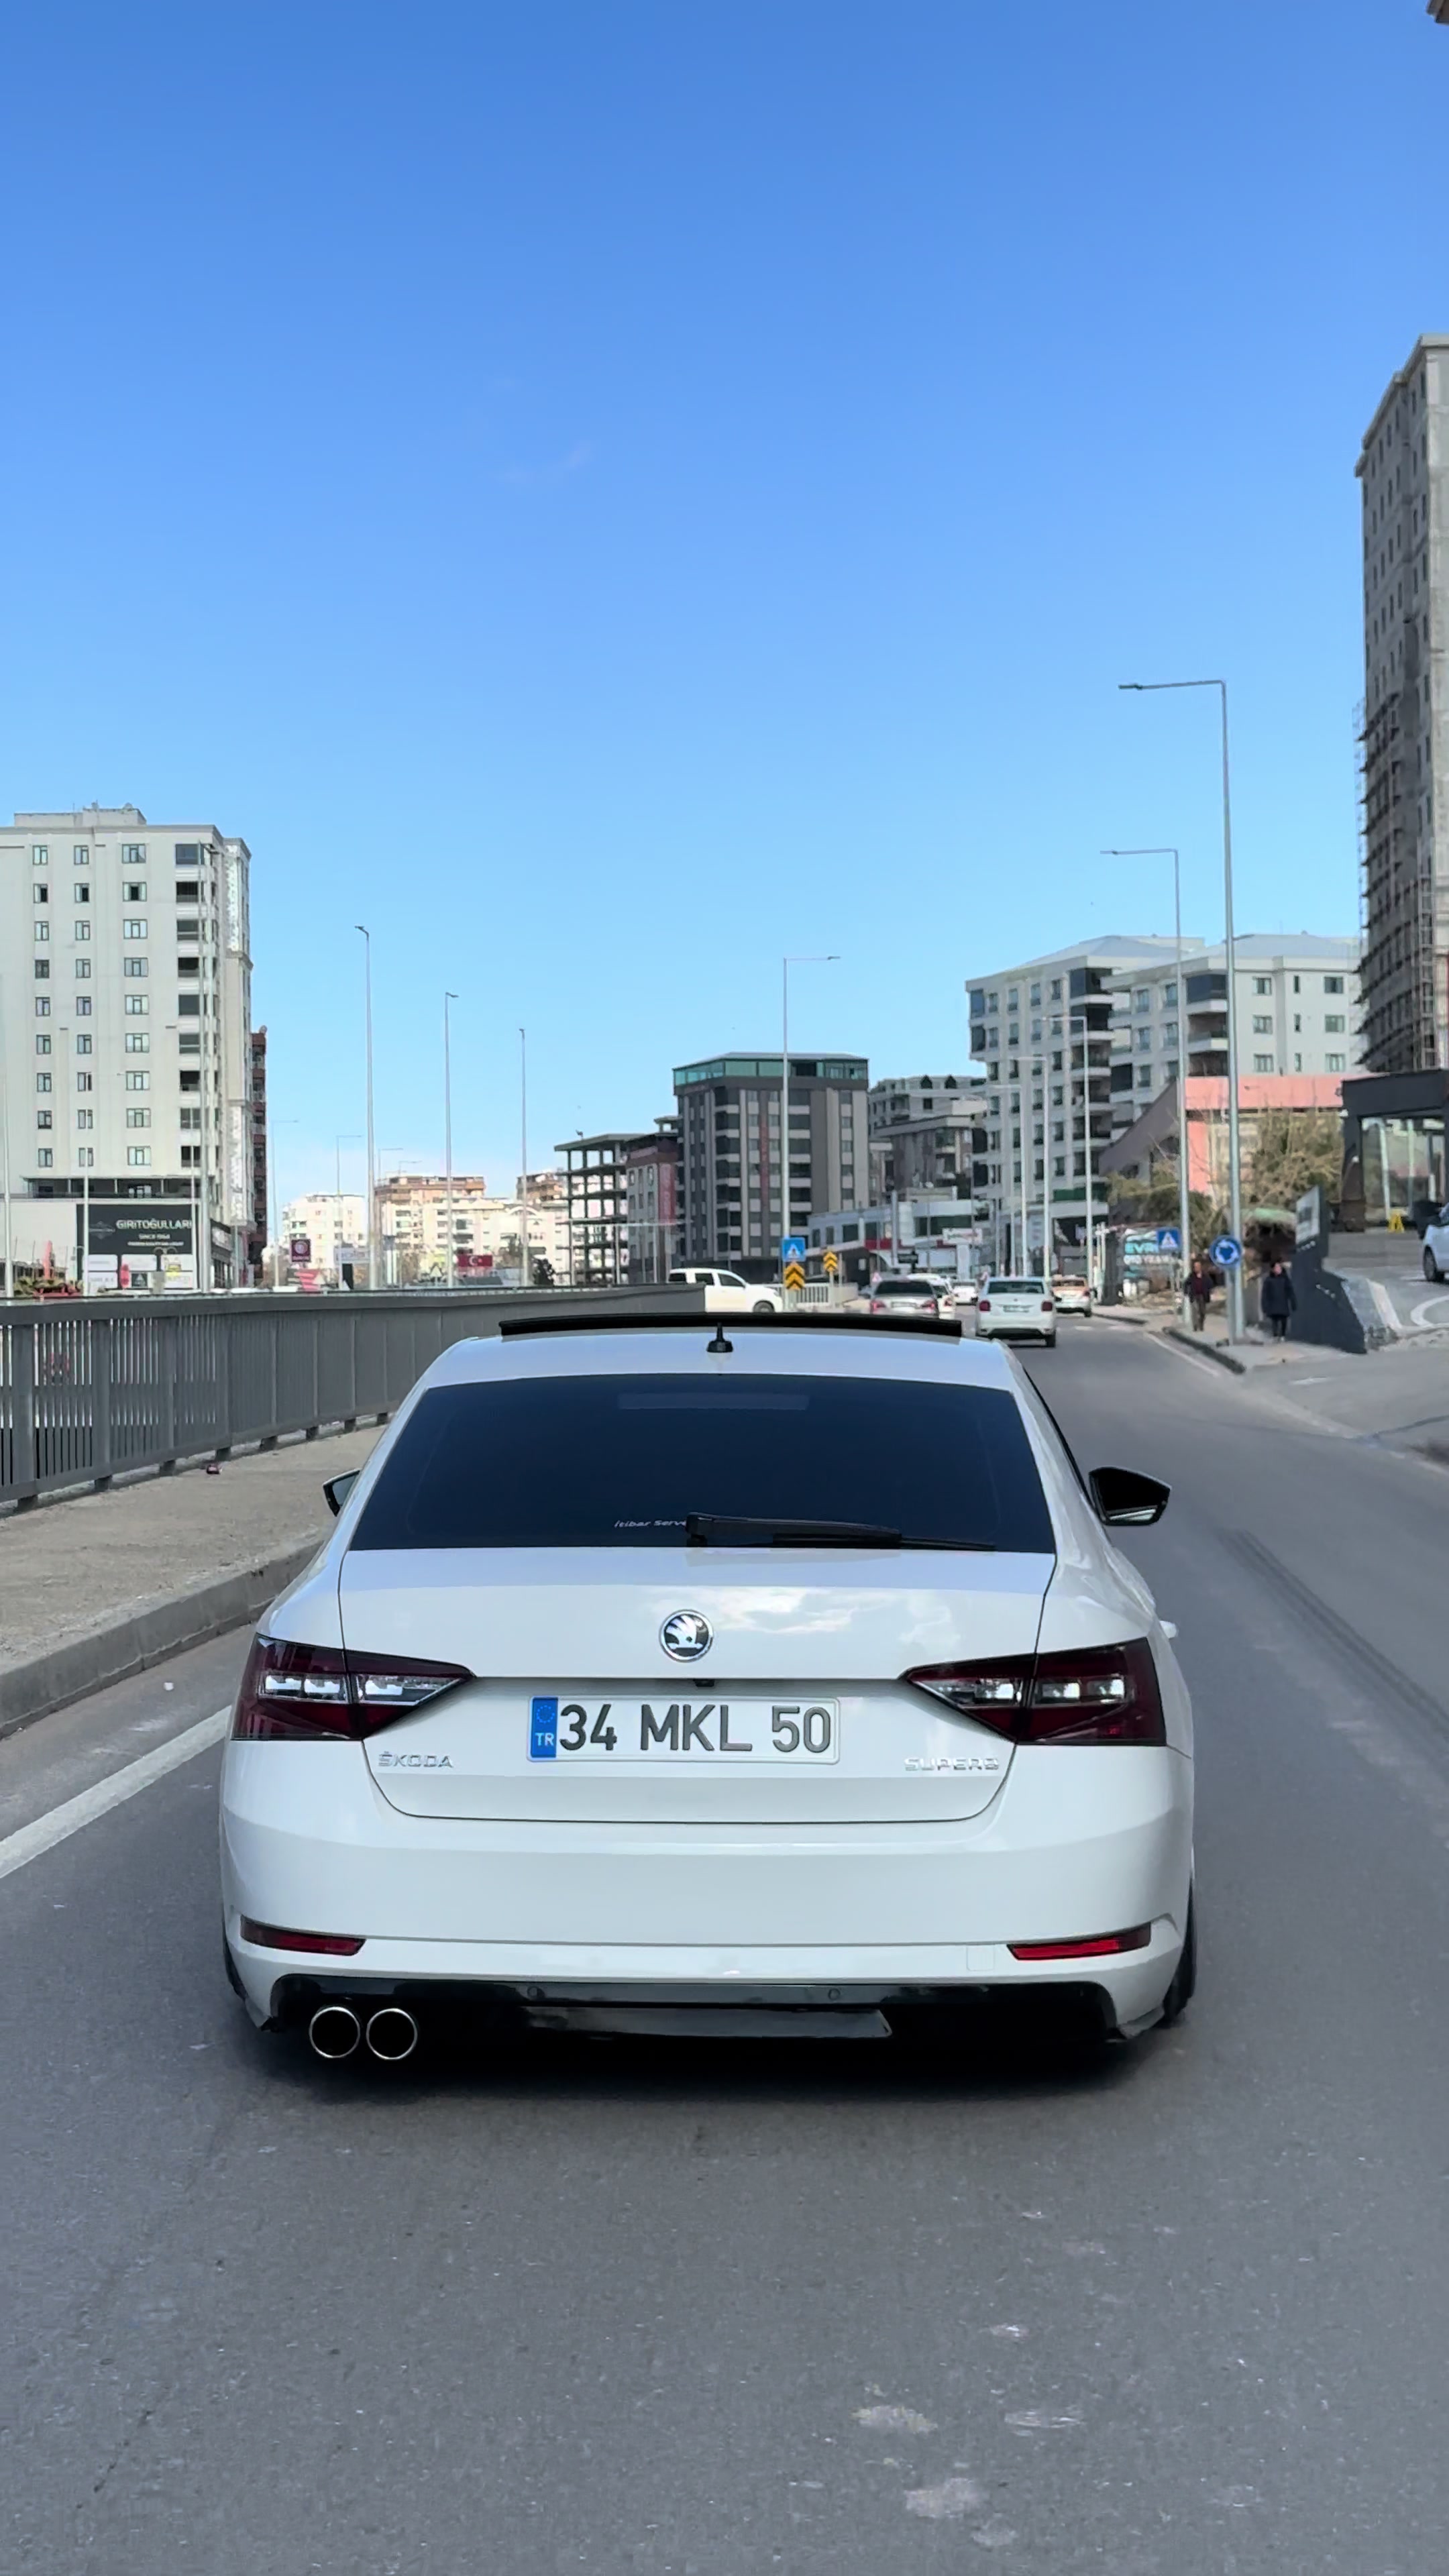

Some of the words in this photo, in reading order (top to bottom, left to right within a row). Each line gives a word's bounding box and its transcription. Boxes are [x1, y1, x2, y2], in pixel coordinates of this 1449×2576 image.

[559, 1704, 618, 1751] 34
[640, 1704, 753, 1752] MKL
[771, 1705, 831, 1754] 50
[535, 1733, 555, 1747] TR
[904, 1758, 1000, 1771] SUPERB
